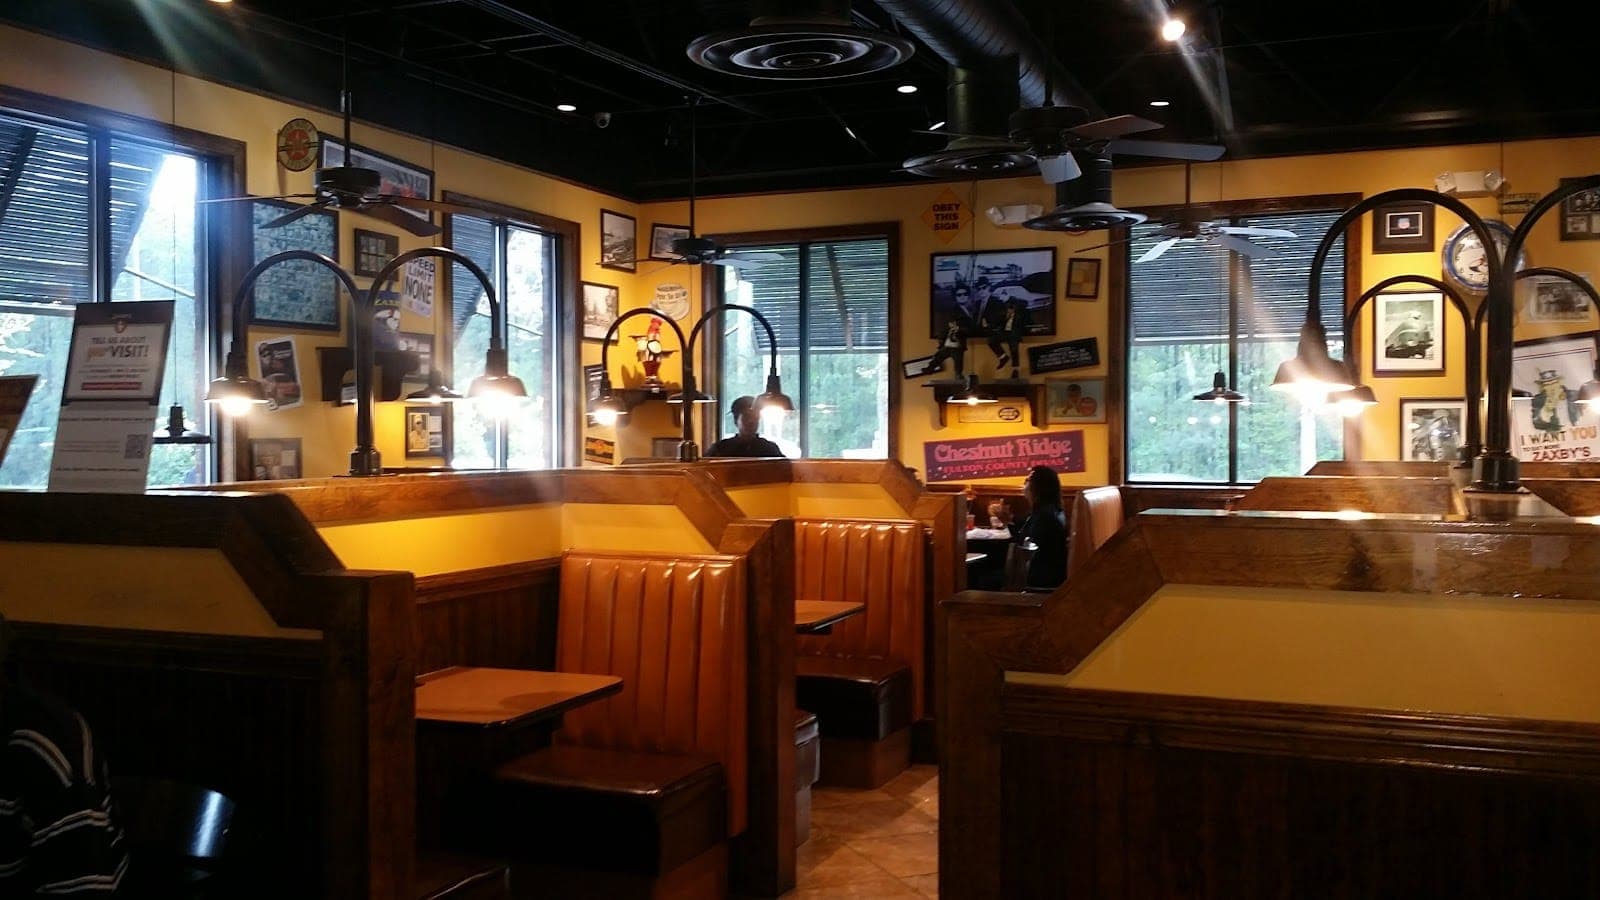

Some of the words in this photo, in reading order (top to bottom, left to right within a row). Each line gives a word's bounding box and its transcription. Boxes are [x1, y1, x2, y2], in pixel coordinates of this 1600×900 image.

[933, 204, 960, 212] OBEY
[934, 213, 959, 221] THIS
[934, 223, 960, 231] SIGN
[409, 257, 435, 273] PEED
[405, 275, 432, 305] NONE
[112, 345, 149, 357] VISIT!
[1529, 431, 1566, 444] WANT
[1570, 426, 1596, 440] YOU
[935, 441, 1014, 462] Chestnut
[1017, 438, 1072, 457] Ridge
[1533, 447, 1590, 460] ZAXBY'S
[986, 461, 1027, 470] COUNTY
